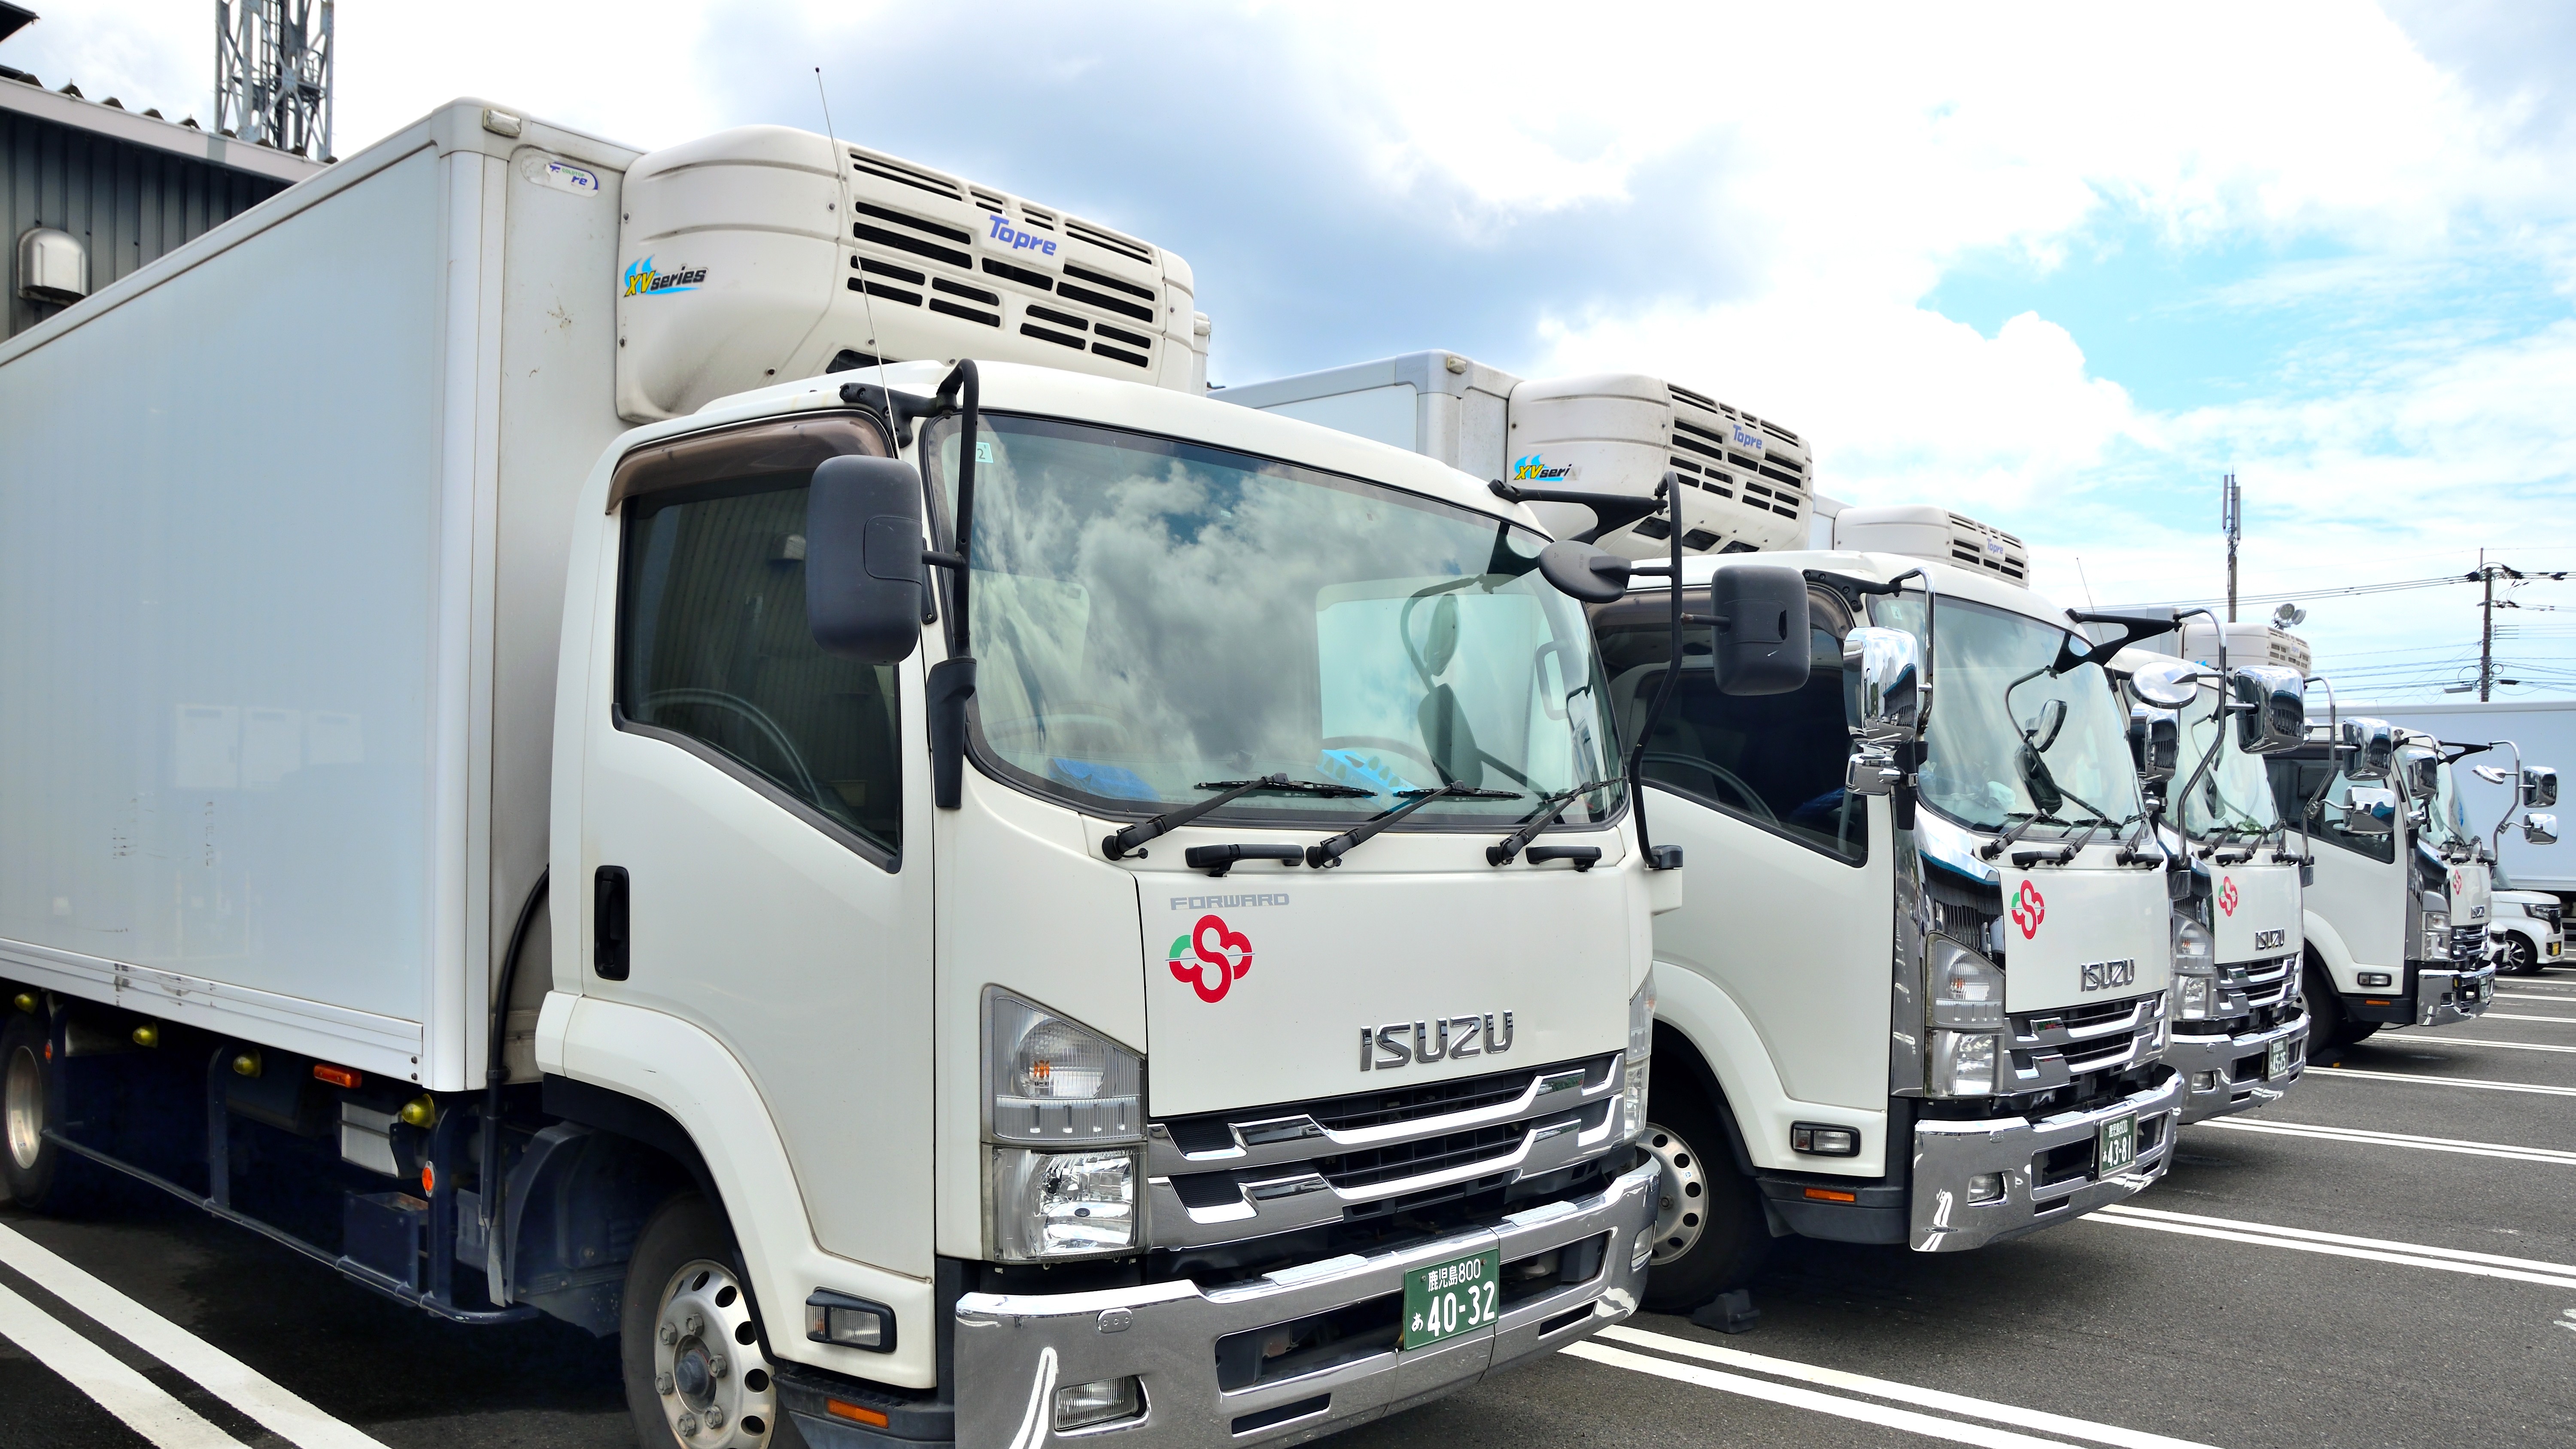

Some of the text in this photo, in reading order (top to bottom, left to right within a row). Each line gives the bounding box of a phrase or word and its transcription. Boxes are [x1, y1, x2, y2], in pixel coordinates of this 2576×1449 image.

[562, 168, 585, 177] COLDTOP
[989, 214, 1057, 256] Topre
[1733, 423, 1762, 450] Topre
[977, 448, 985, 459] 2
[1987, 538, 2003, 554] Topre
[1170, 893, 1289, 910] FORWARD
[2081, 957, 2135, 992] ISUZU
[1360, 1009, 1513, 1072] ISUZU
[2108, 1135, 2131, 1166] 43-81
[1411, 1281, 1495, 1337] あ 40-32
